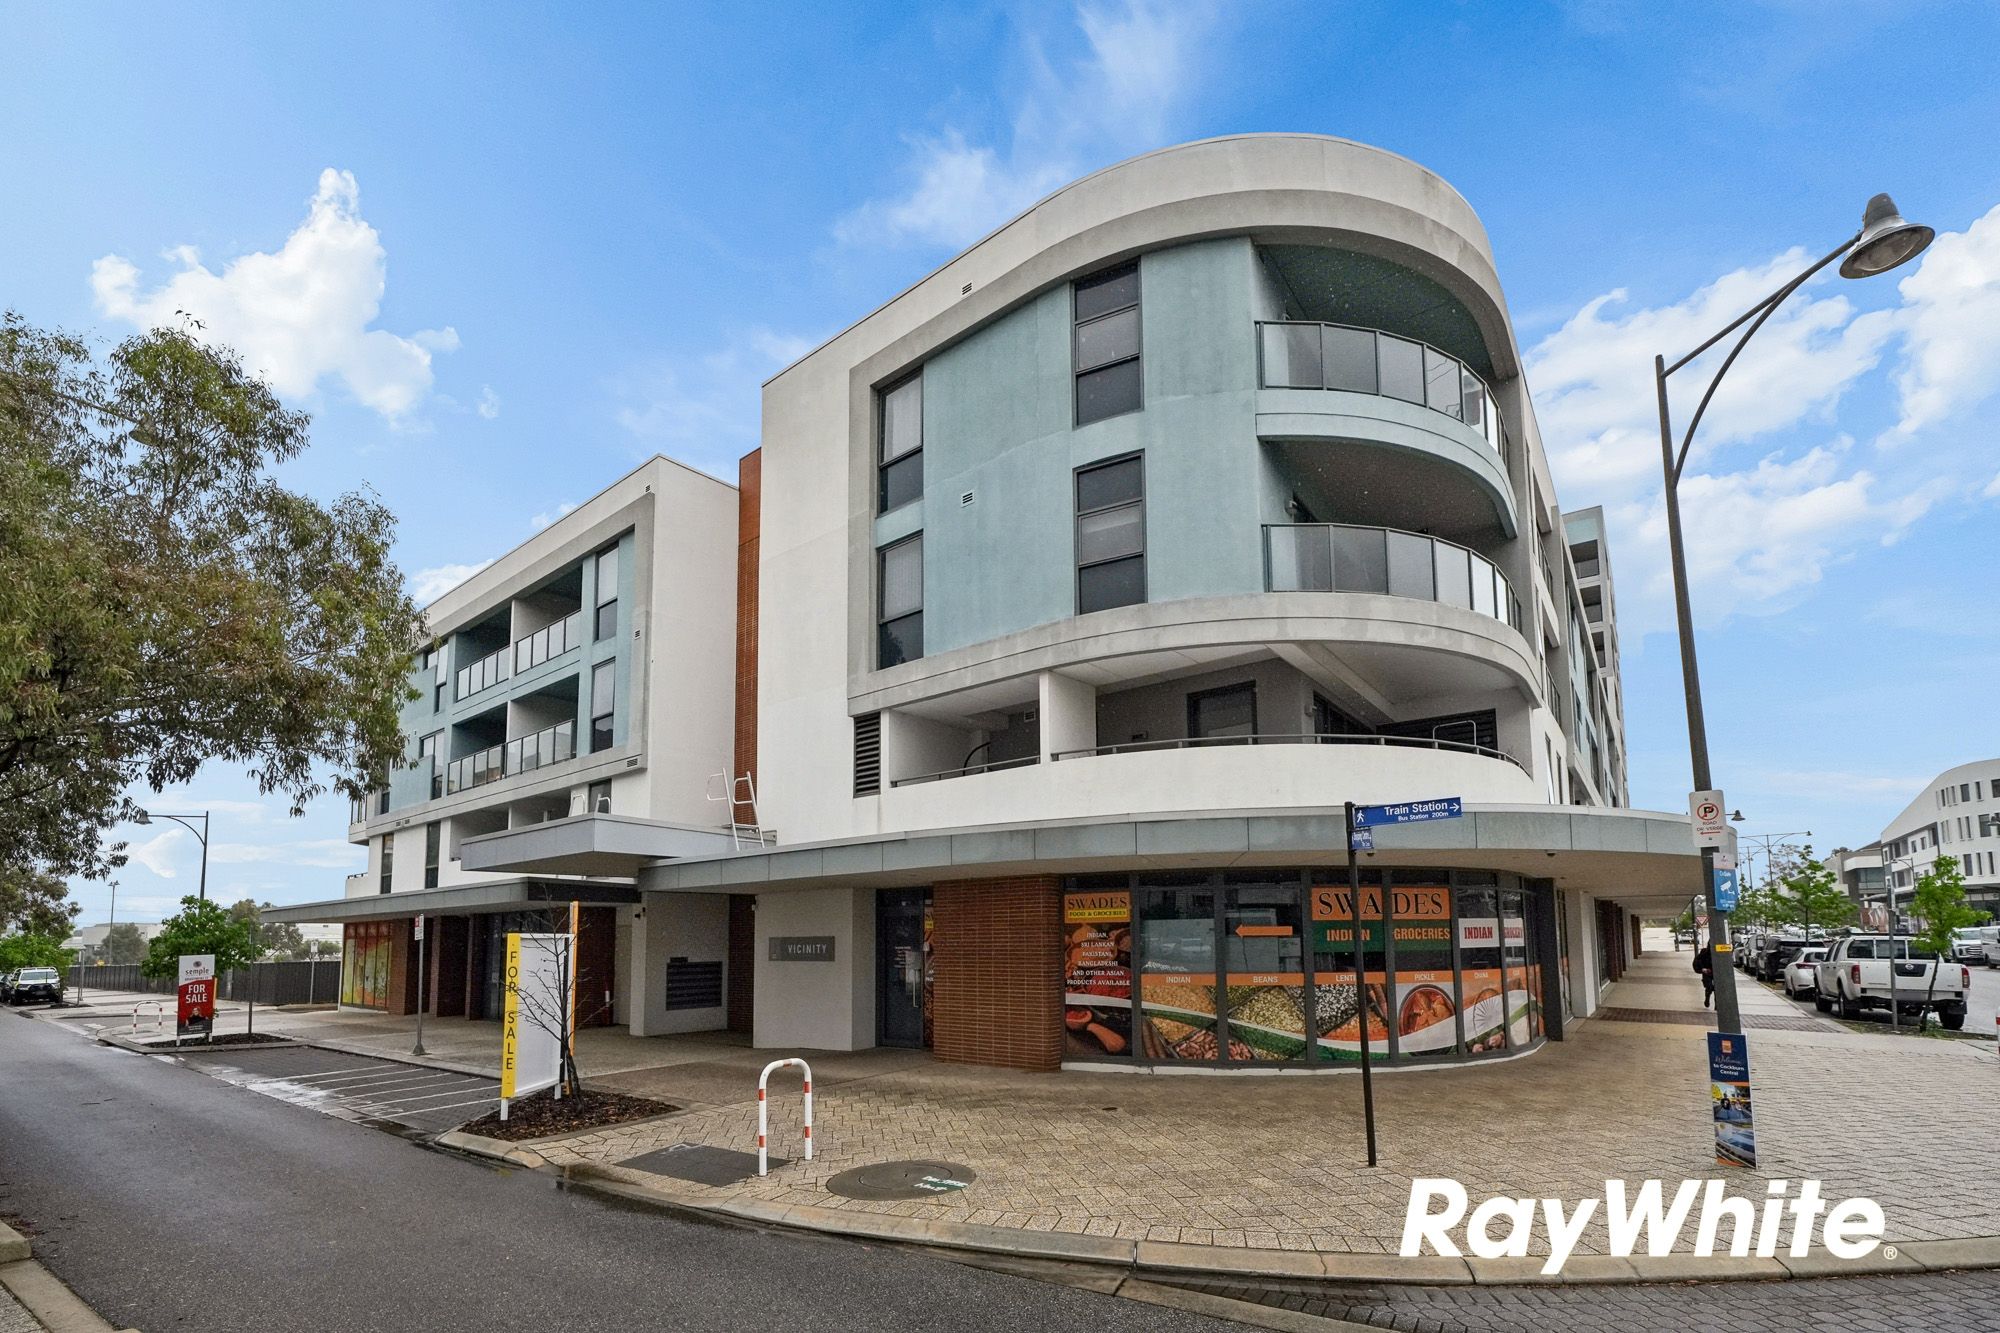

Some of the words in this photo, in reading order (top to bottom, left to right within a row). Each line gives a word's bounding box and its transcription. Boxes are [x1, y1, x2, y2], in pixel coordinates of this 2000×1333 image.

[1384, 806, 1409, 816] Train
[1412, 801, 1448, 813] Station
[1068, 896, 1128, 909] SWADES
[1319, 892, 1443, 915] SWADES
[1326, 928, 1370, 942] INDIN
[1393, 927, 1451, 940] GROCERIES
[1464, 926, 1493, 939] INDIAN
[787, 944, 827, 954] VICINITY
[185, 967, 209, 976] semple
[508, 951, 518, 993] FOR
[1252, 975, 1279, 983] BEANS
[1335, 974, 1357, 982] LENTI
[1414, 973, 1435, 981] PICKLE
[188, 984, 206, 994] FOR
[185, 993, 208, 1004] SALE
[506, 1011, 516, 1070] SALE
[1720, 1063, 1745, 1071] Cockburn
[1719, 1069, 1739, 1077] Central
